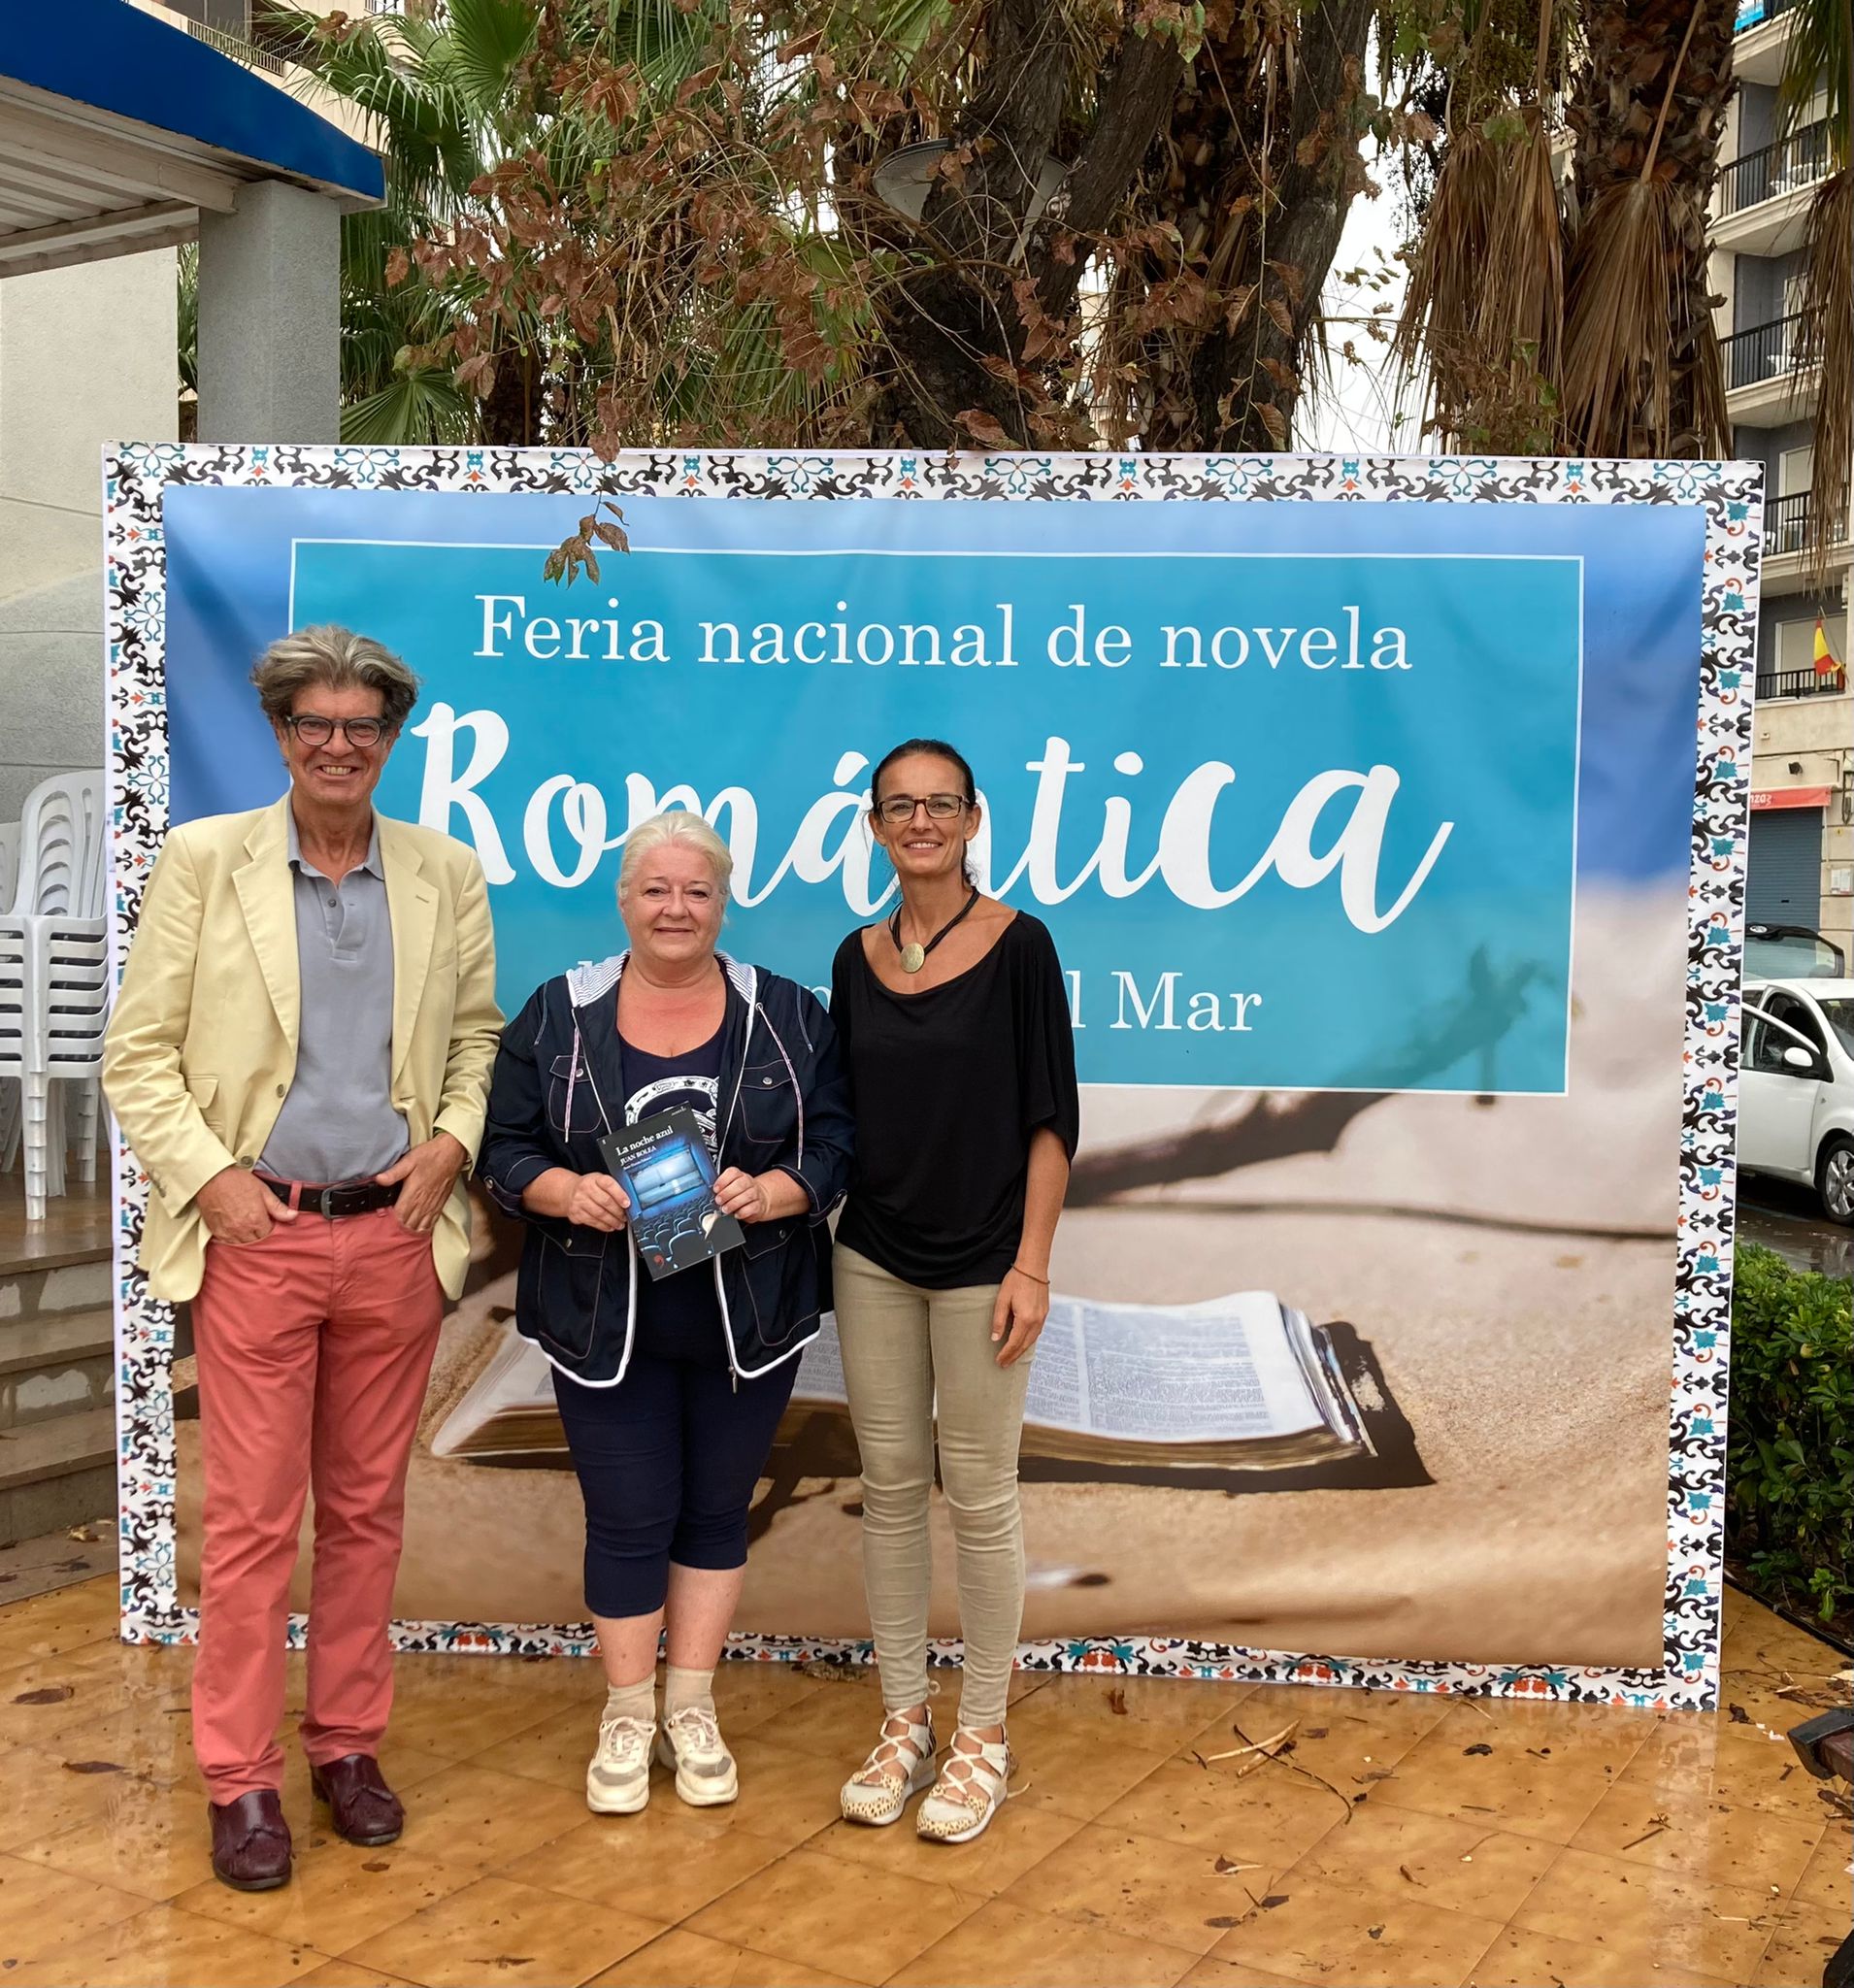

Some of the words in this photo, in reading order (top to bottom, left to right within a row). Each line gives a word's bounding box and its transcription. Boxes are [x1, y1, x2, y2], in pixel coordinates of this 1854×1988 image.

[474, 595, 672, 664] Feria
[699, 604, 1018, 669] nacional
[1047, 604, 1132, 669] de
[1161, 604, 1412, 670] novela
[1109, 970, 1263, 1032] Mar
[615, 1146, 630, 1156] La
[629, 1135, 655, 1150] noche
[655, 1125, 674, 1139] azul
